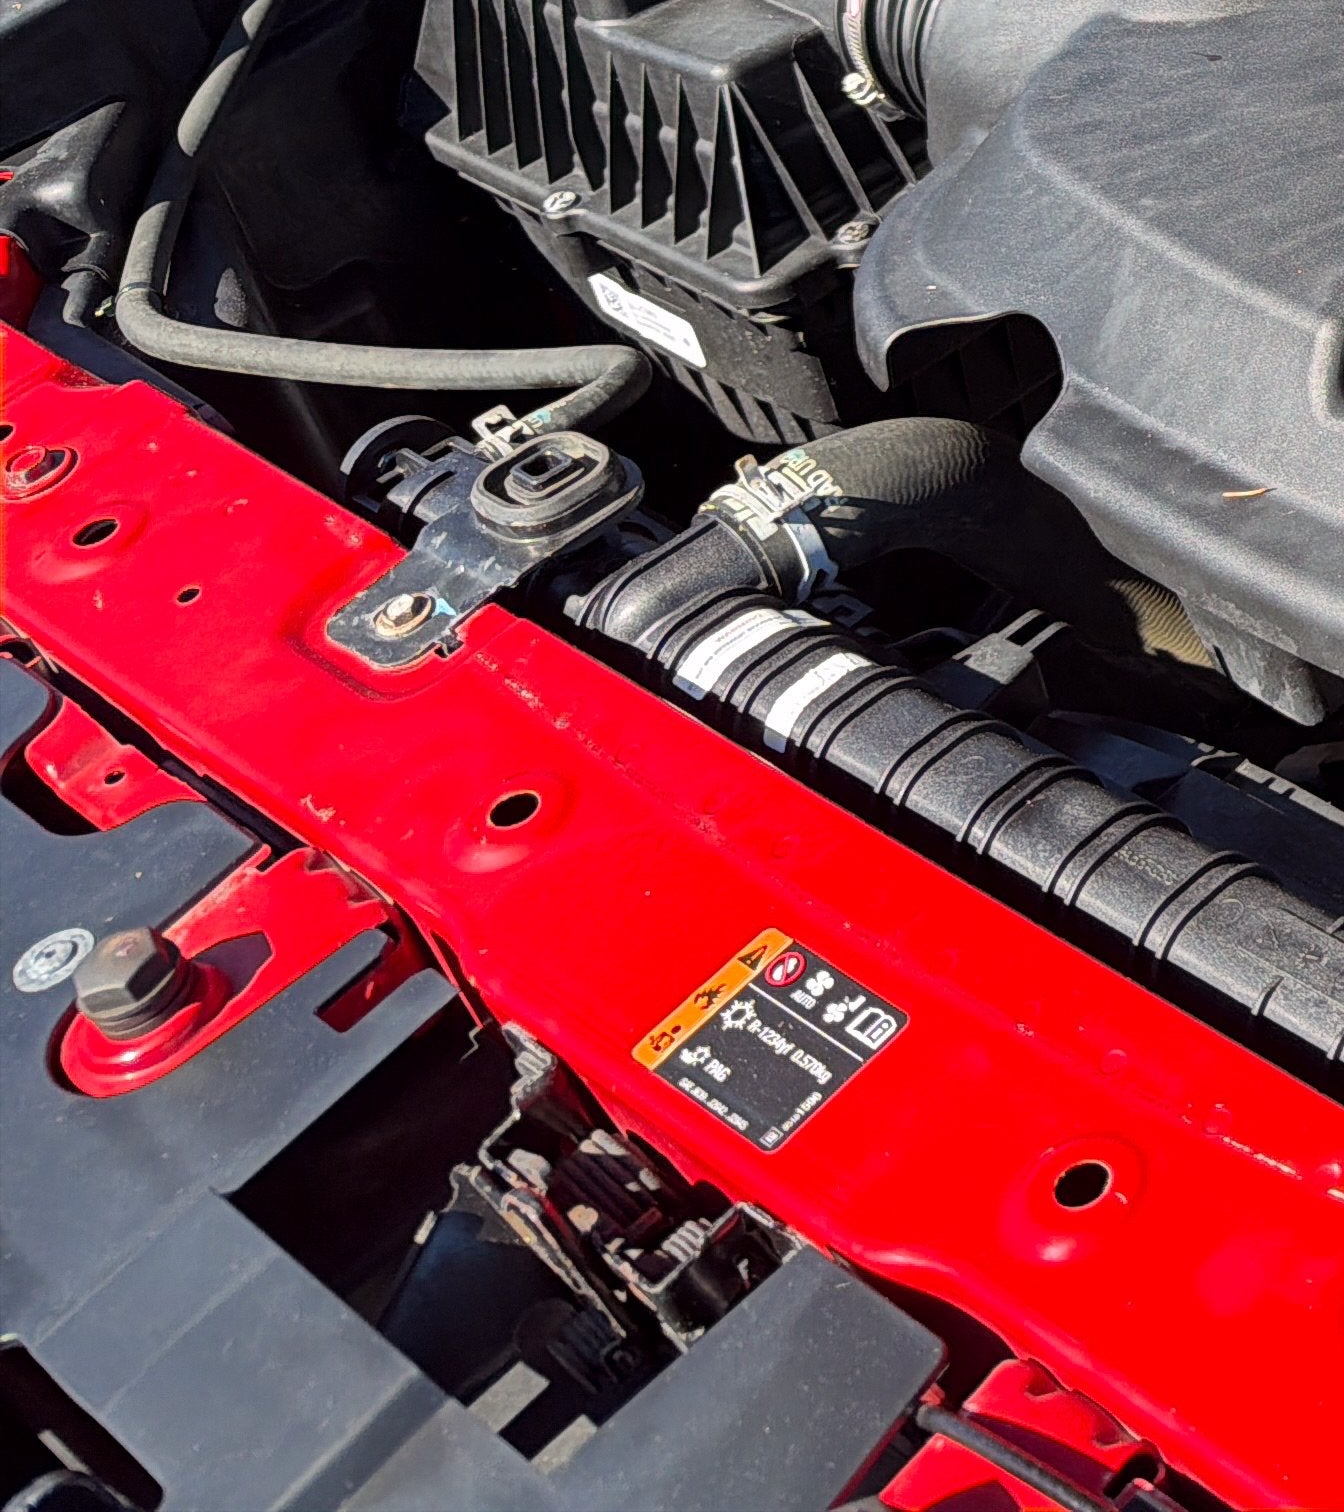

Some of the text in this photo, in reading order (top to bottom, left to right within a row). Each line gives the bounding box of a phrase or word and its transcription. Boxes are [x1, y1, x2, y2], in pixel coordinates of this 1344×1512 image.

[789, 989, 817, 1010] AUTO
[747, 1018, 796, 1055] R-1234yf
[704, 1058, 732, 1084] PAG
